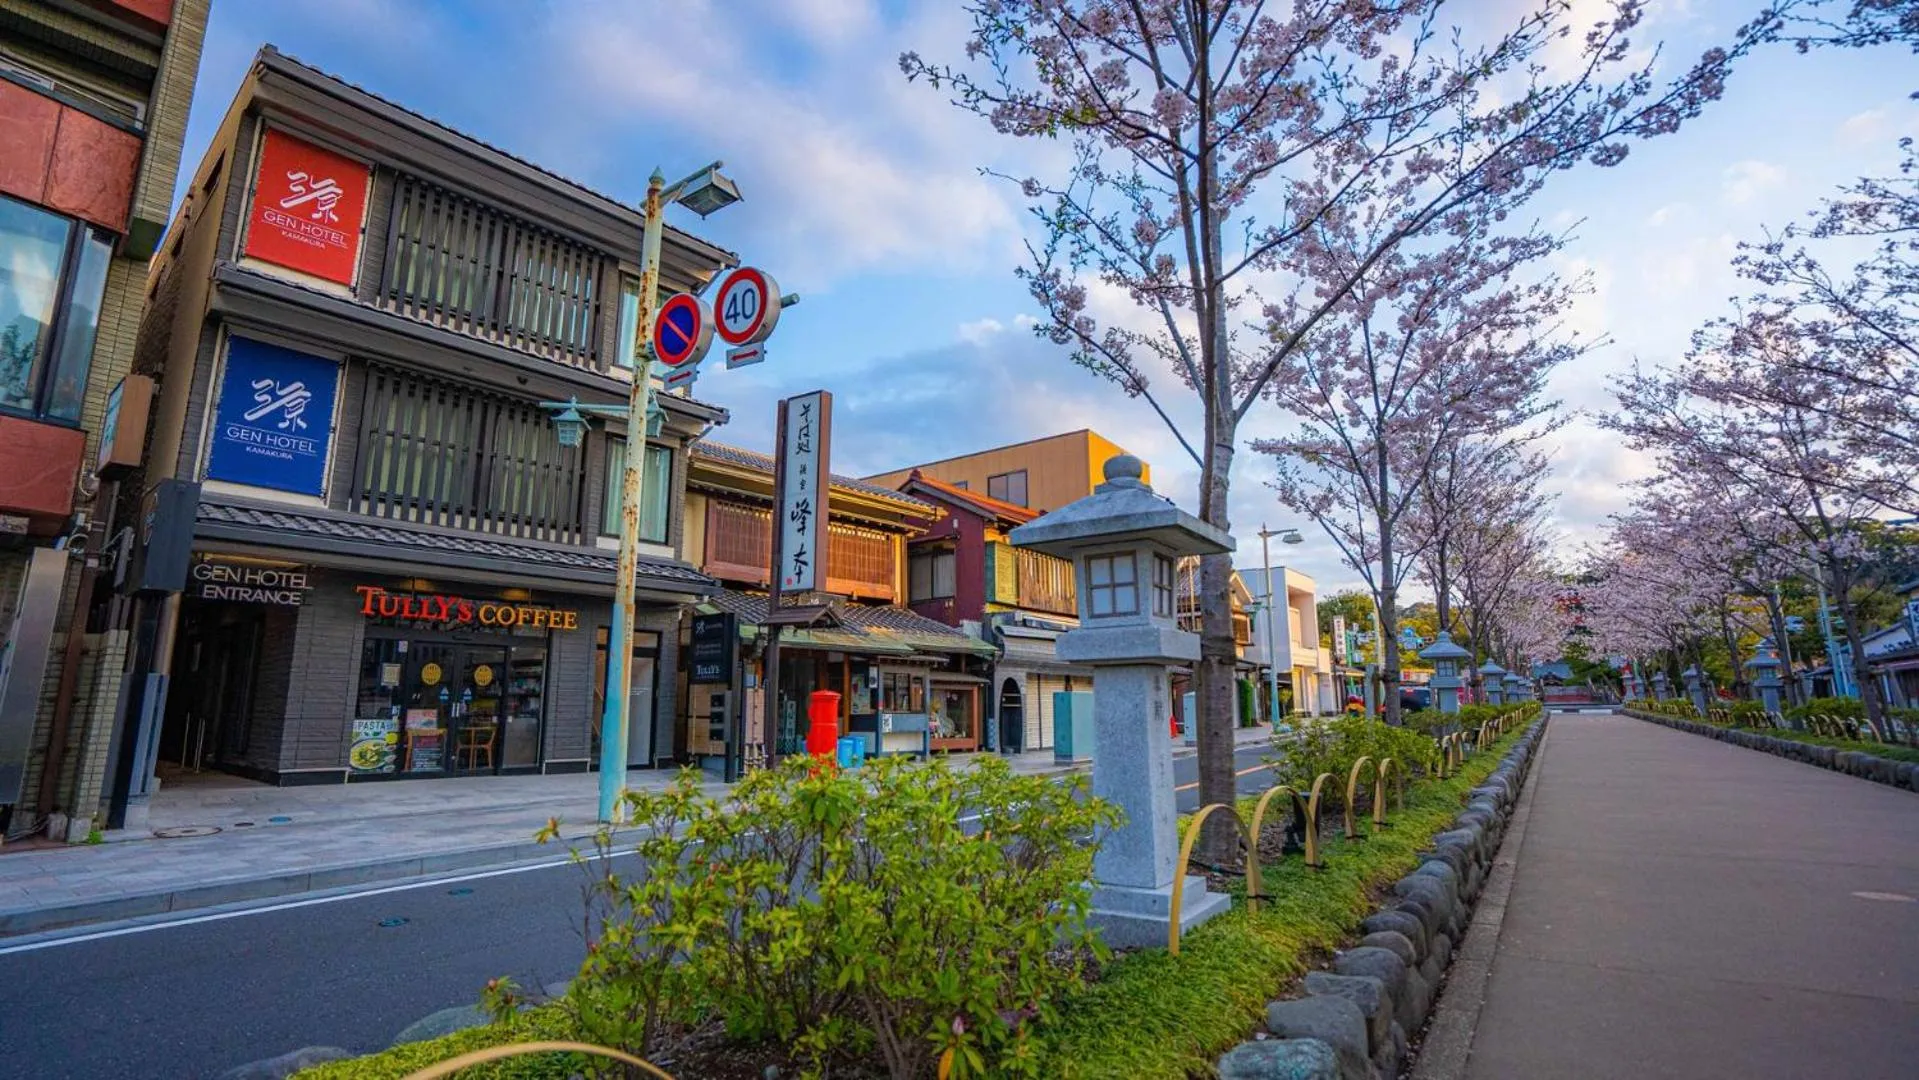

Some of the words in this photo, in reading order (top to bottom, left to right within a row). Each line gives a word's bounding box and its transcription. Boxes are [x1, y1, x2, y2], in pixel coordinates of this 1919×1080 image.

[263, 210, 297, 229] GEN
[301, 222, 347, 245] HOTEL
[724, 288, 756, 324] 40
[227, 426, 262, 443] GEN
[266, 434, 316, 453] HOTEL
[246, 446, 294, 460] KAMAKURA
[193, 563, 241, 583] GEN
[245, 568, 314, 590] HOTEL
[203, 584, 302, 605] ENTRANCE
[478, 603, 578, 629] COFFEE
[357, 721, 386, 731] PASTA
